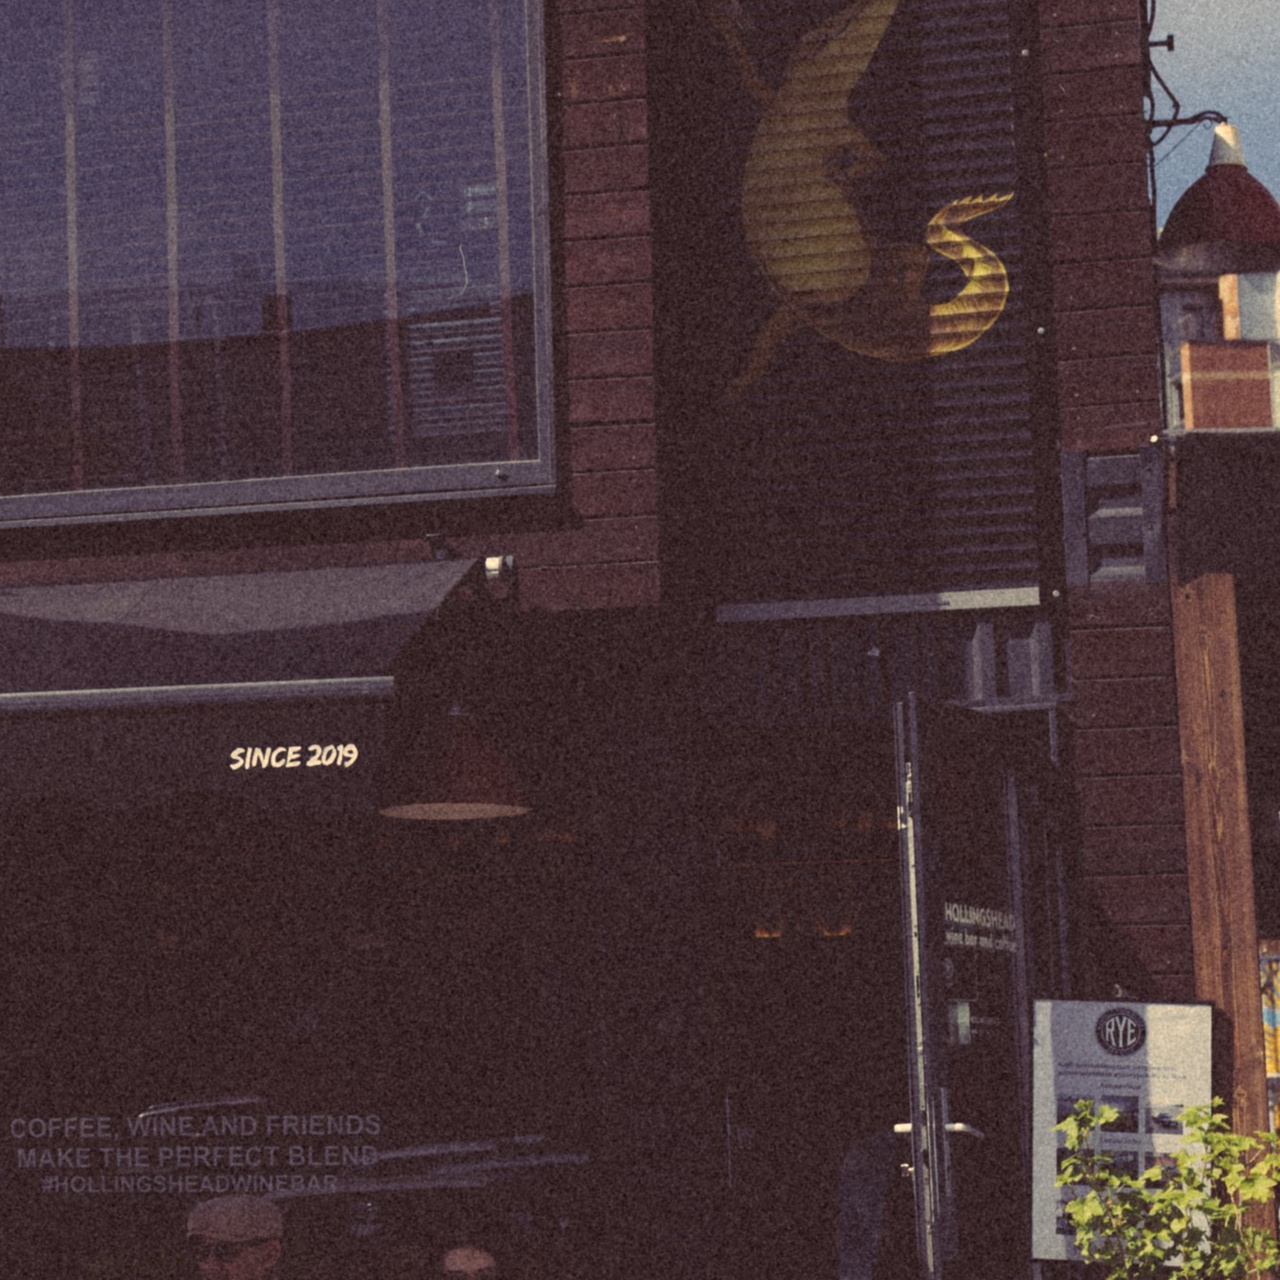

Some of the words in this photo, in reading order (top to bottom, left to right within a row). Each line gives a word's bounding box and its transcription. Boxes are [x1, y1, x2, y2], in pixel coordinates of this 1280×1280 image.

[229, 746, 302, 770] SINCE
[306, 743, 359, 768] 2019
[1106, 1016, 1137, 1048] RYE
[10, 1117, 119, 1142] COFFEE,
[127, 1116, 195, 1137] WINE
[201, 1115, 258, 1136] AND
[266, 1114, 381, 1136] FRIENDS
[17, 1147, 92, 1168] MAKE
[100, 1146, 150, 1168] THE
[159, 1145, 281, 1167] PERFECT
[289, 1145, 377, 1167] BLEND
[41, 1174, 338, 1194] #HOLLINGSHEADWINEBAR
